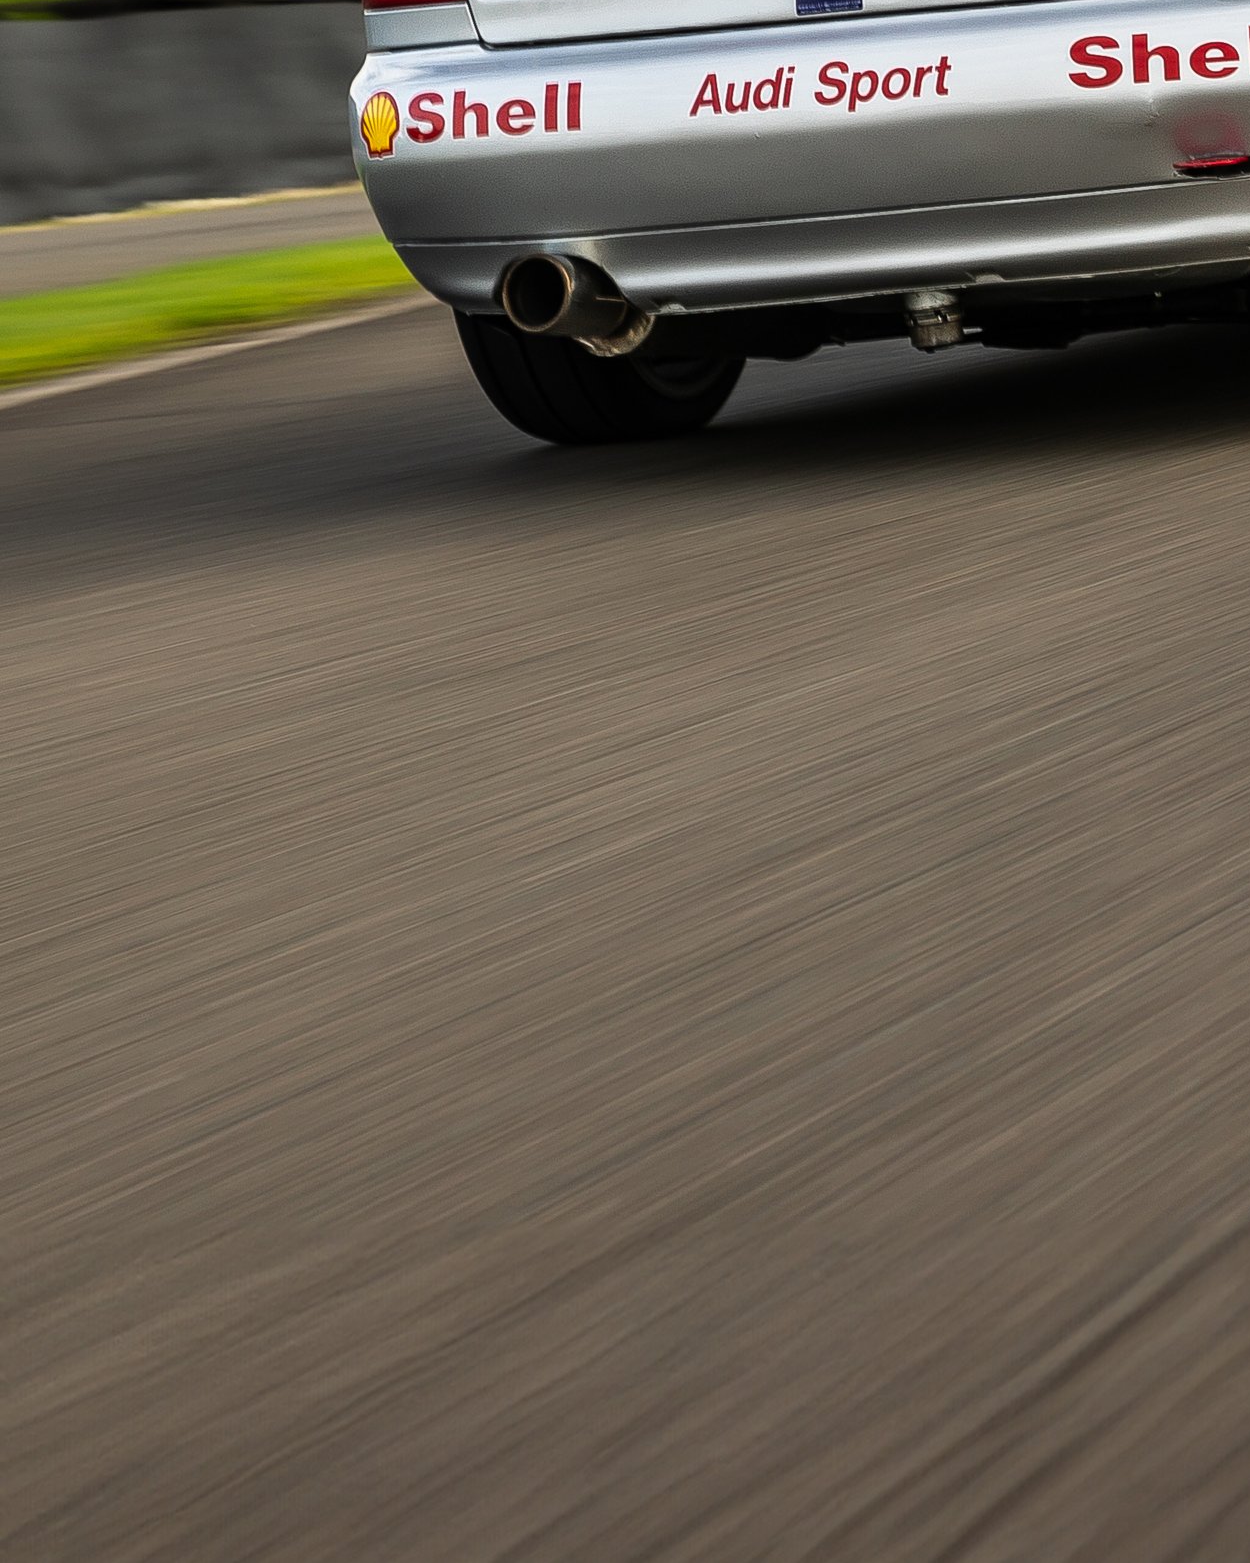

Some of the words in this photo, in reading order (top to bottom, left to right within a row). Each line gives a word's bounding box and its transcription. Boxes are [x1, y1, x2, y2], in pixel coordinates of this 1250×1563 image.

[406, 82, 582, 143] Shell
[690, 67, 794, 117] Audi
[814, 56, 952, 112] Sport
